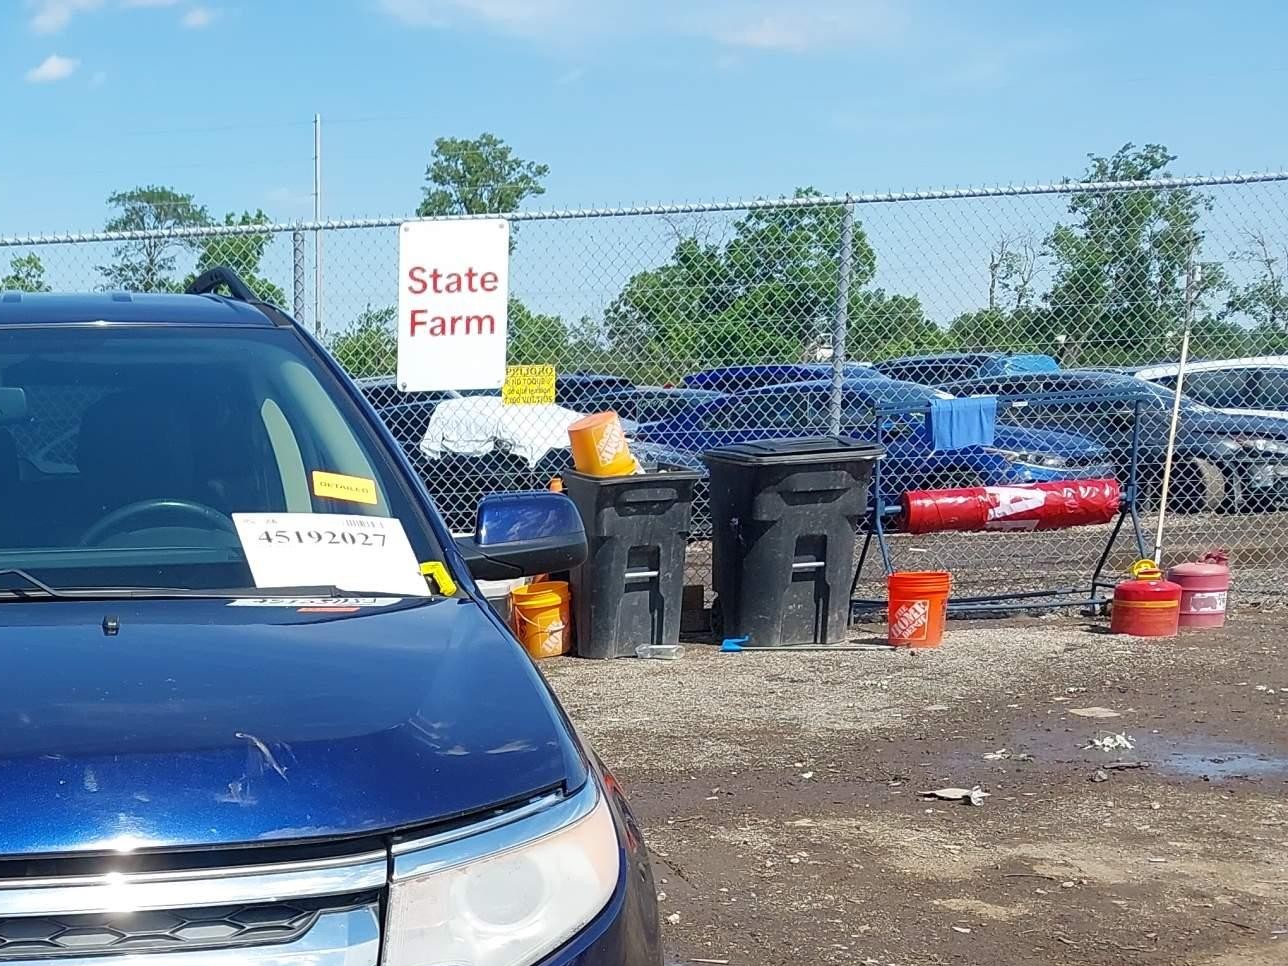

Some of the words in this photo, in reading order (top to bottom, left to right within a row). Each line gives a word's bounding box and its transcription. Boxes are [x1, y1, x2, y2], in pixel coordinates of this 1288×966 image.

[407, 266, 499, 294] State
[409, 309, 495, 337] Farm
[319, 481, 369, 494] DETAILED
[258, 530, 386, 547] 45192027
[891, 599, 928, 639] HOME
